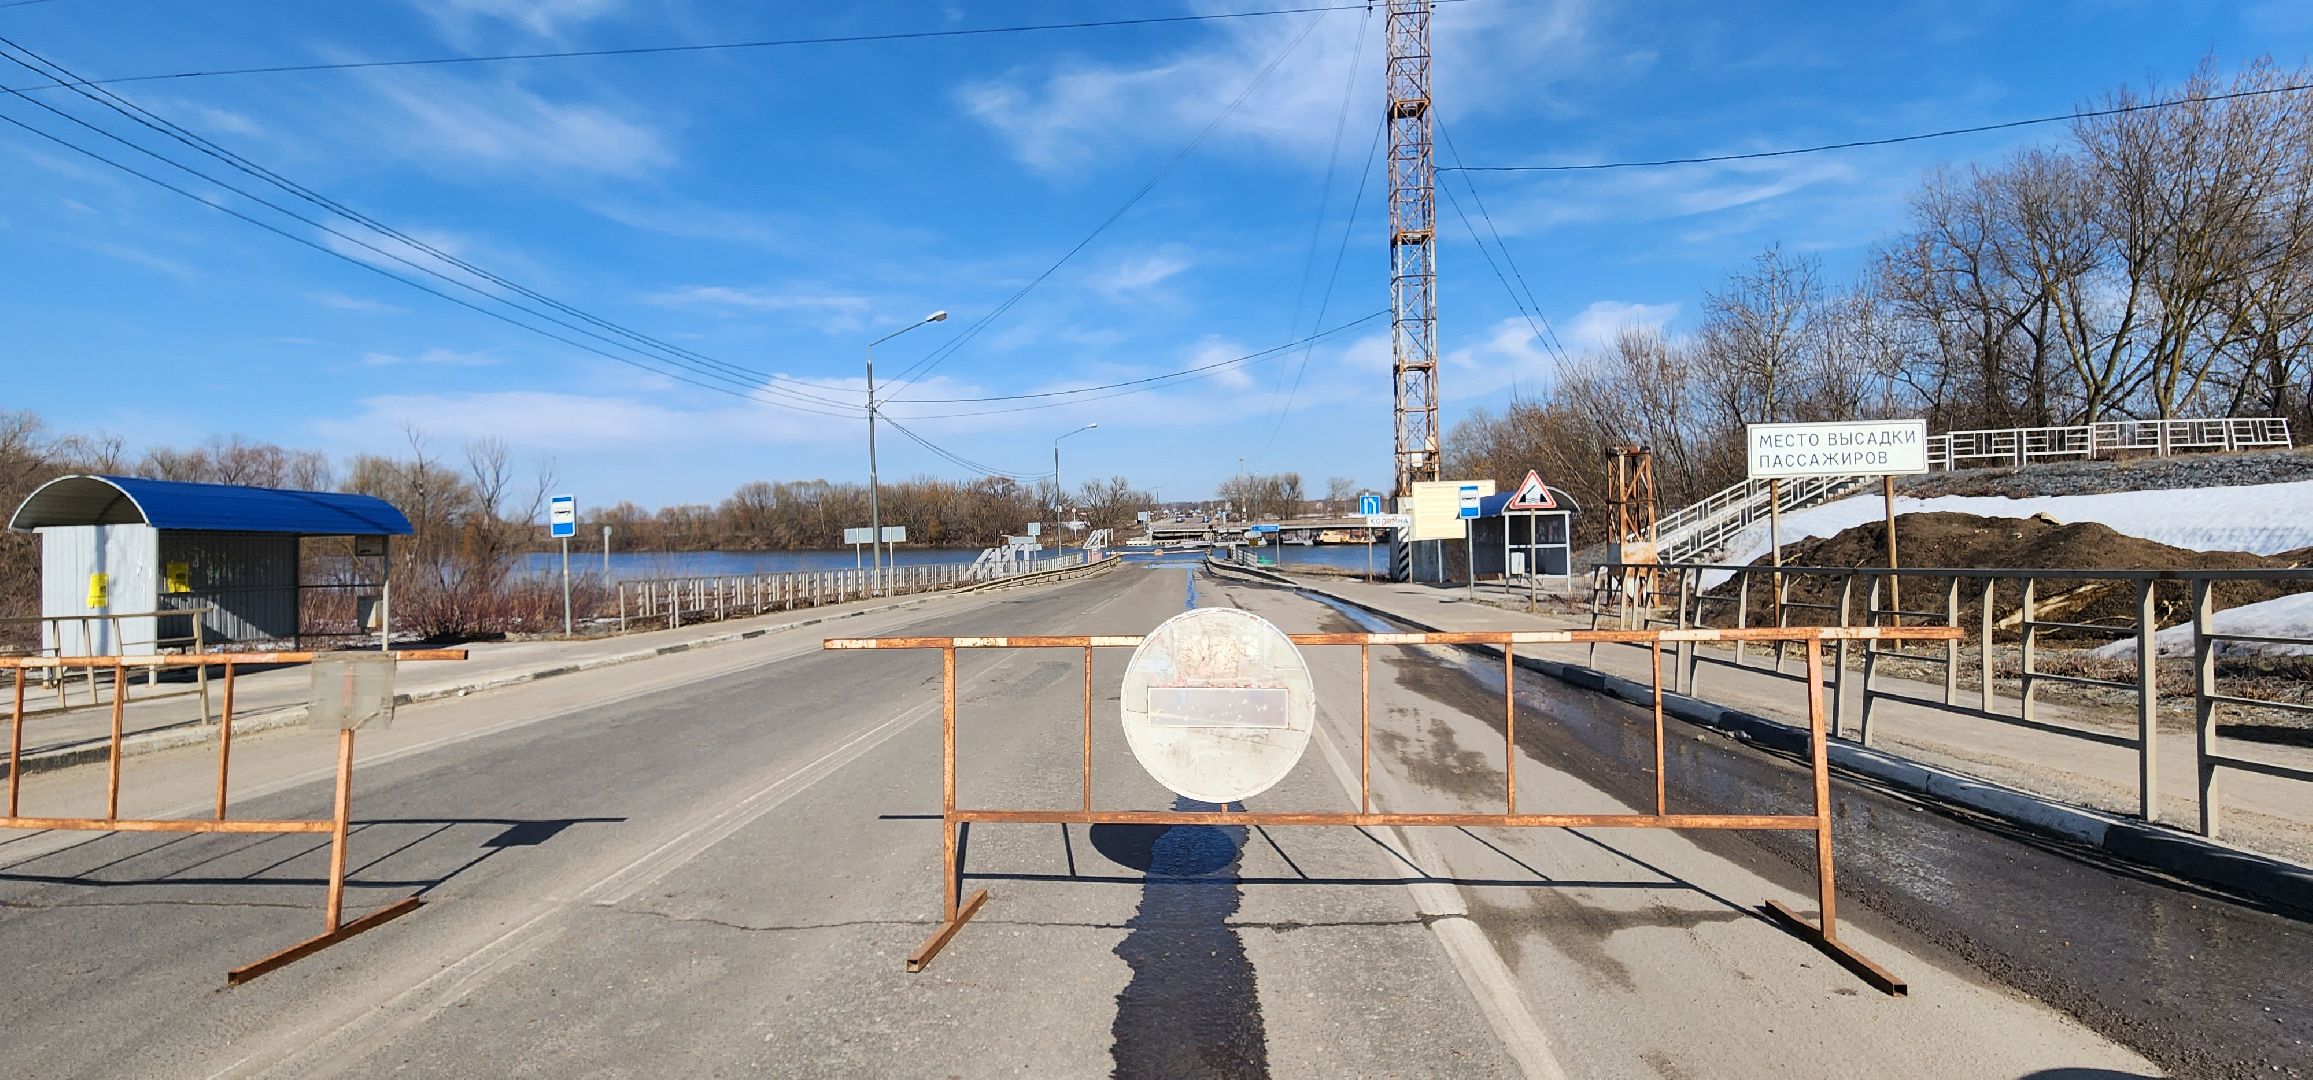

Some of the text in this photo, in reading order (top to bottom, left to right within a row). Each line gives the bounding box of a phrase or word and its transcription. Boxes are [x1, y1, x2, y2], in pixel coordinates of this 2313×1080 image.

[1759, 430, 1915, 448] МЕСТО ВЫСАДКИ
[1759, 451, 1888, 468] ПАССАЖИРОВ
